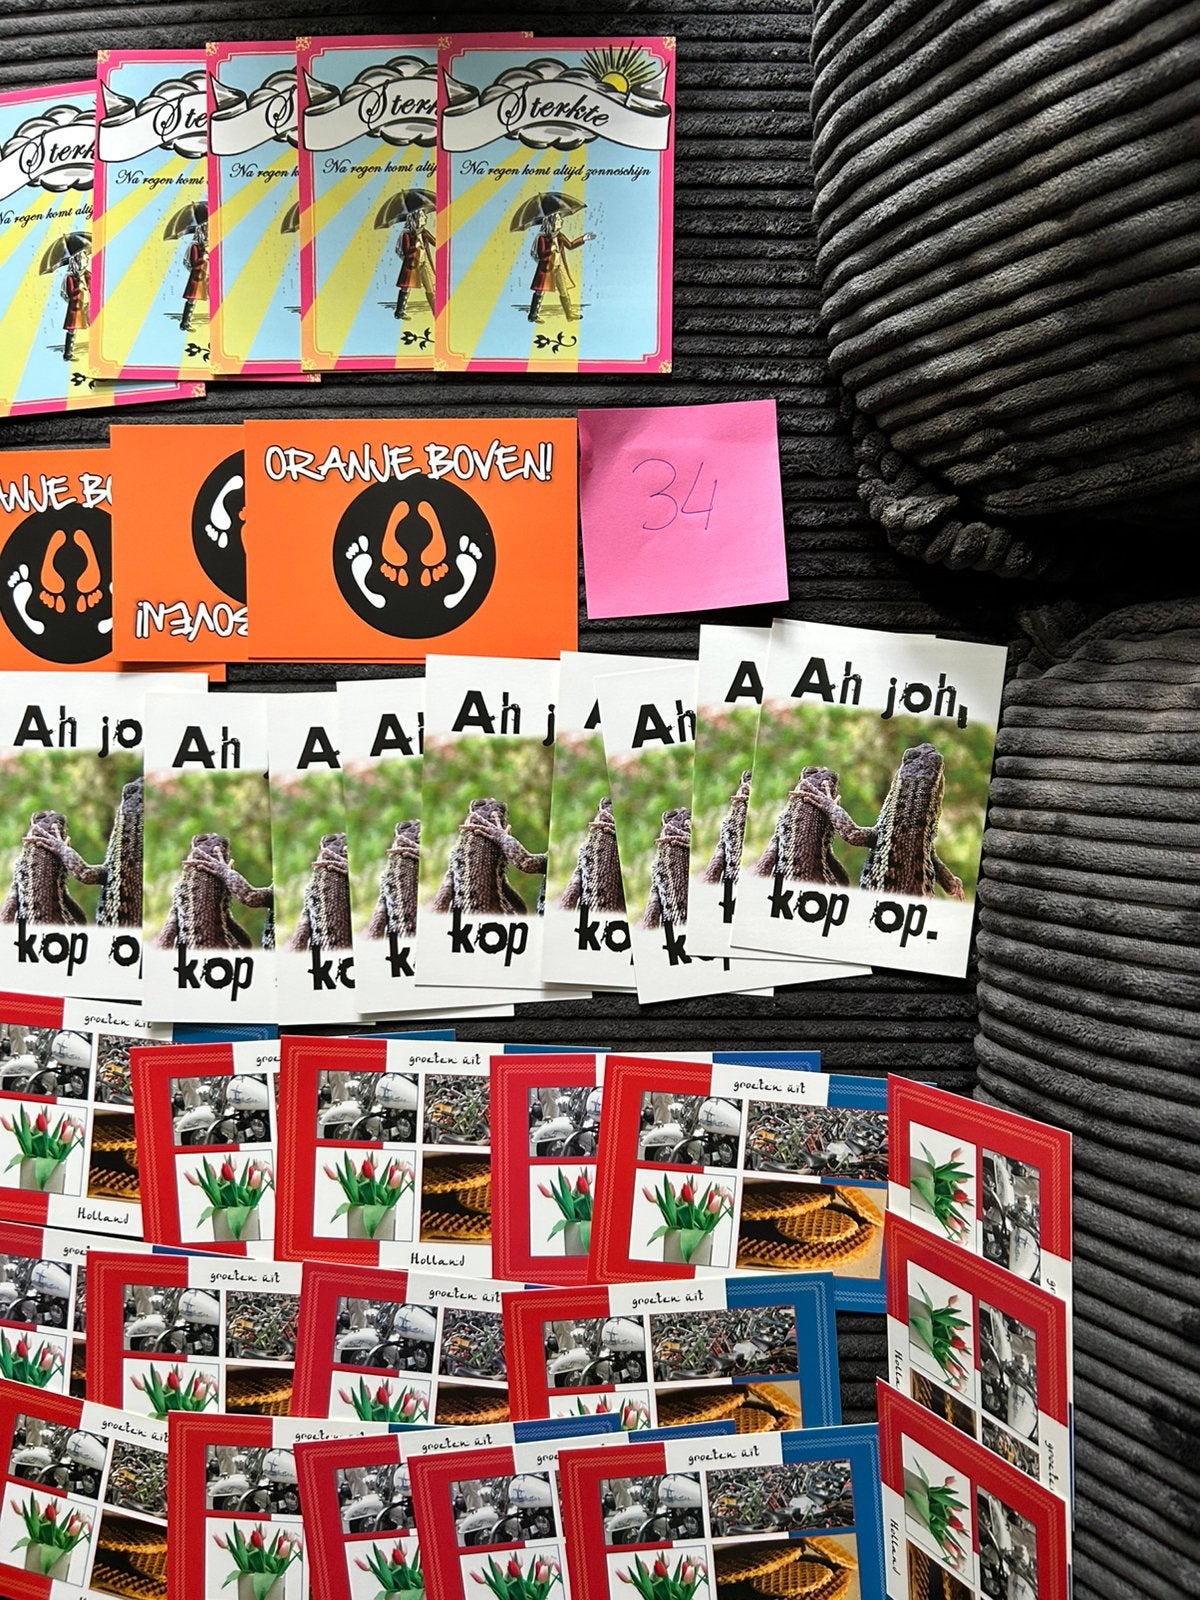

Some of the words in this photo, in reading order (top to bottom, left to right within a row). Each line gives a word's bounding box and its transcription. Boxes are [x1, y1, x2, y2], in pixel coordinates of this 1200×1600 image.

[496, 81, 610, 133] Sterkte
[229, 162, 257, 178] Na
[257, 170, 288, 183] regen
[322, 158, 352, 174] Na
[351, 163, 381, 179] regen
[384, 161, 413, 173] komt
[459, 159, 489, 176] Na
[488, 167, 520, 180] regen
[522, 164, 551, 176] komt
[553, 164, 584, 181] altijd
[582, 164, 651, 181] zonneschijn
[115, 169, 144, 185] Na
[143, 176, 174, 190] regen
[175, 173, 205, 186] komt
[14, 214, 44, 229] regen
[46, 207, 73, 220] komt
[264, 443, 422, 483] ORANJE
[423, 438, 553, 482] BOVEN!
[632, 458, 718, 531] 34
[790, 656, 863, 706] Ah
[881, 672, 969, 729] joh,
[450, 690, 522, 735] Ah
[13, 704, 77, 748] Ah
[632, 699, 696, 748] Ah
[172, 726, 240, 769] Ah
[768, 872, 850, 938] kop
[869, 900, 939, 948] op.
[447, 904, 529, 967] kop
[574, 903, 634, 966] ko
[13, 917, 88, 977] kop
[107, 935, 143, 980] o
[173, 942, 254, 1002] kop
[84, 1013, 130, 1026] groeten
[408, 1051, 458, 1067] groeten
[733, 1078, 782, 1092] groeten
[77, 1206, 129, 1225] Holland
[62, 1245, 91, 1257] groe
[410, 1252, 465, 1267] Holland
[210, 1269, 258, 1283] groeten
[428, 1287, 478, 1300] groeten
[632, 1292, 681, 1309] groeten
[101, 1420, 147, 1438] groeten
[422, 1437, 470, 1454] groeten
[688, 1448, 737, 1466] groeten
